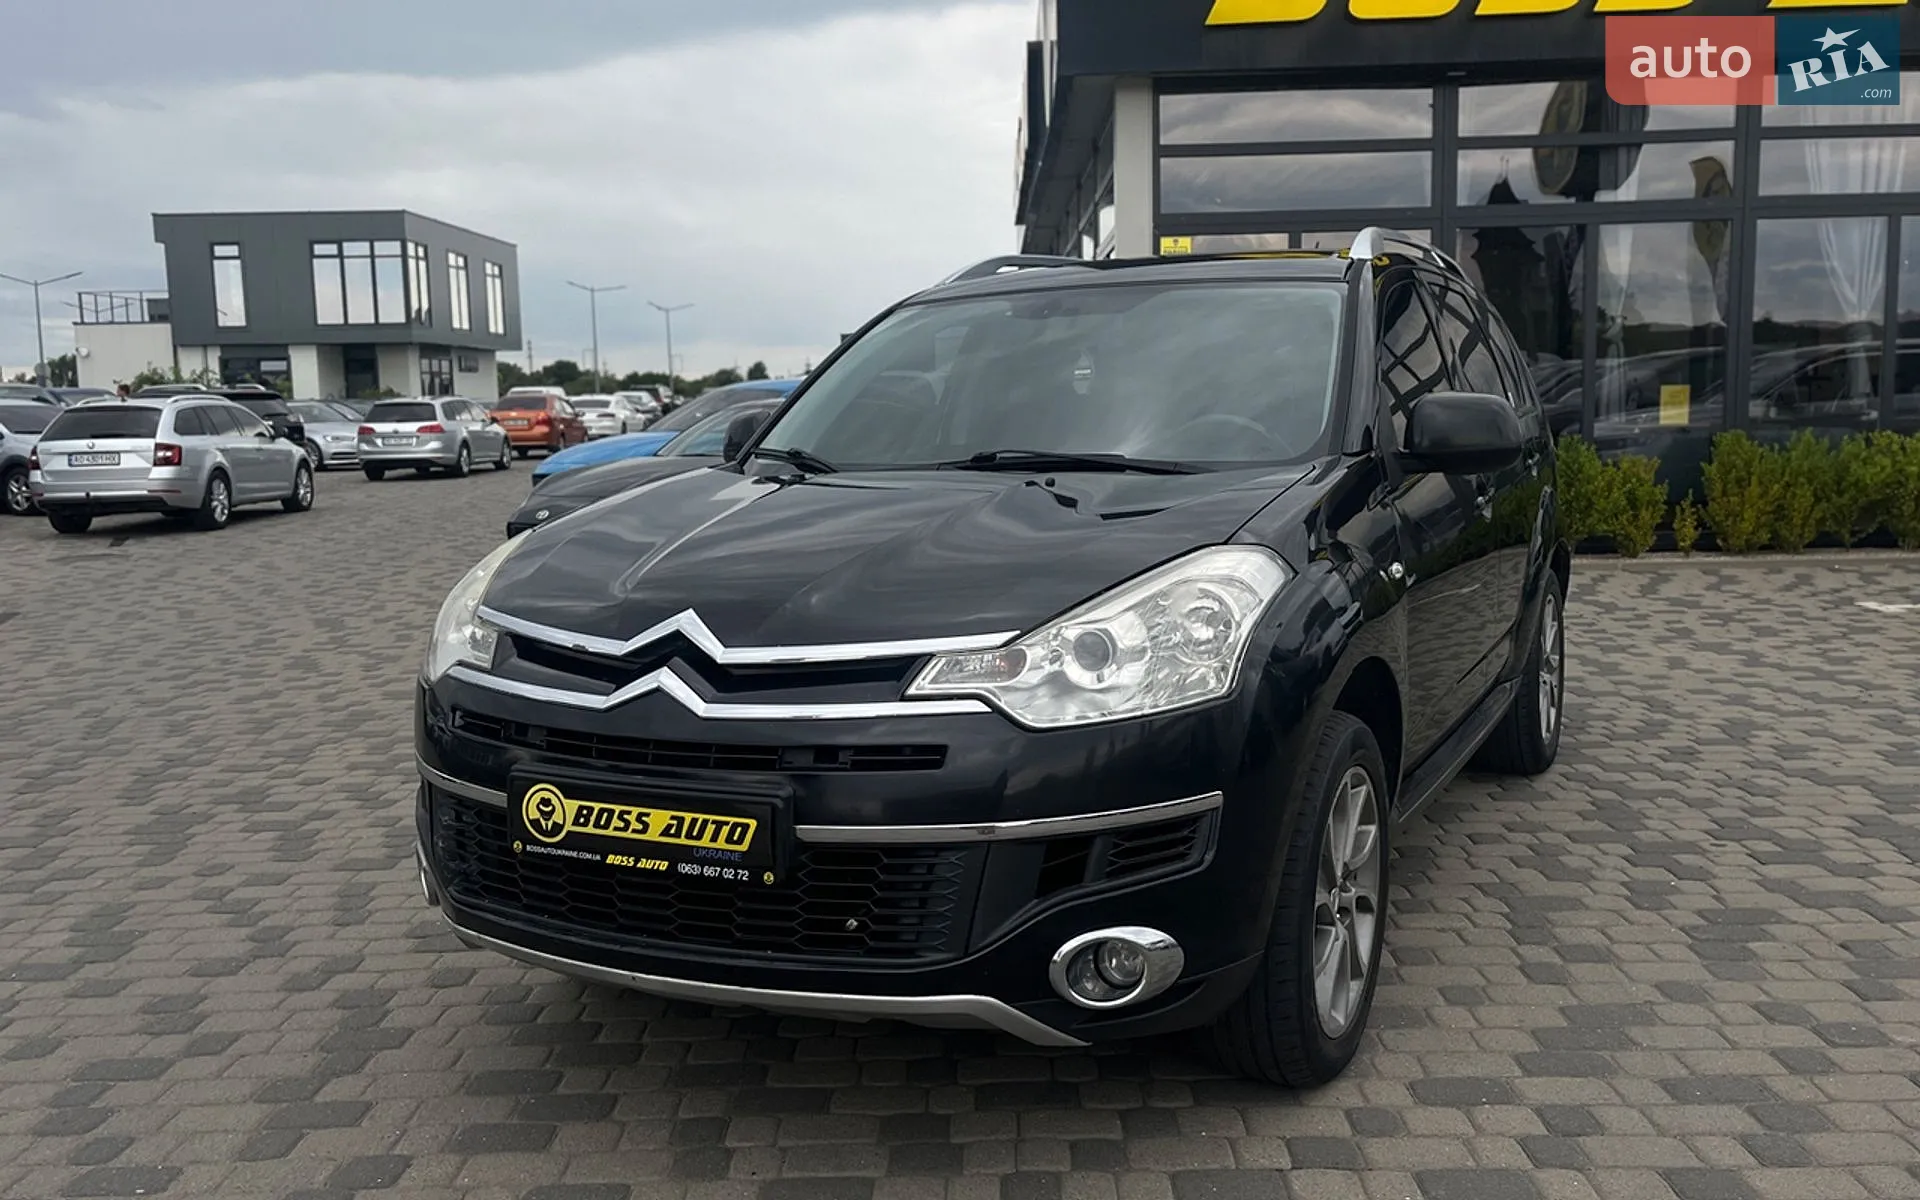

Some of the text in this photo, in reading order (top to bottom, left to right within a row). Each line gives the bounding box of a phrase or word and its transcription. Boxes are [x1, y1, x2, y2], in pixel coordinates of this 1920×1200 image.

[571, 804, 751, 846] BOSS AUTO
[526, 845, 601, 860] BOSSAUTOUKRAINE.COM.UA
[693, 848, 744, 861] UKRAINE
[605, 854, 669, 871] BOSS AUTO
[677, 863, 749, 881] (063) 667 02 72
